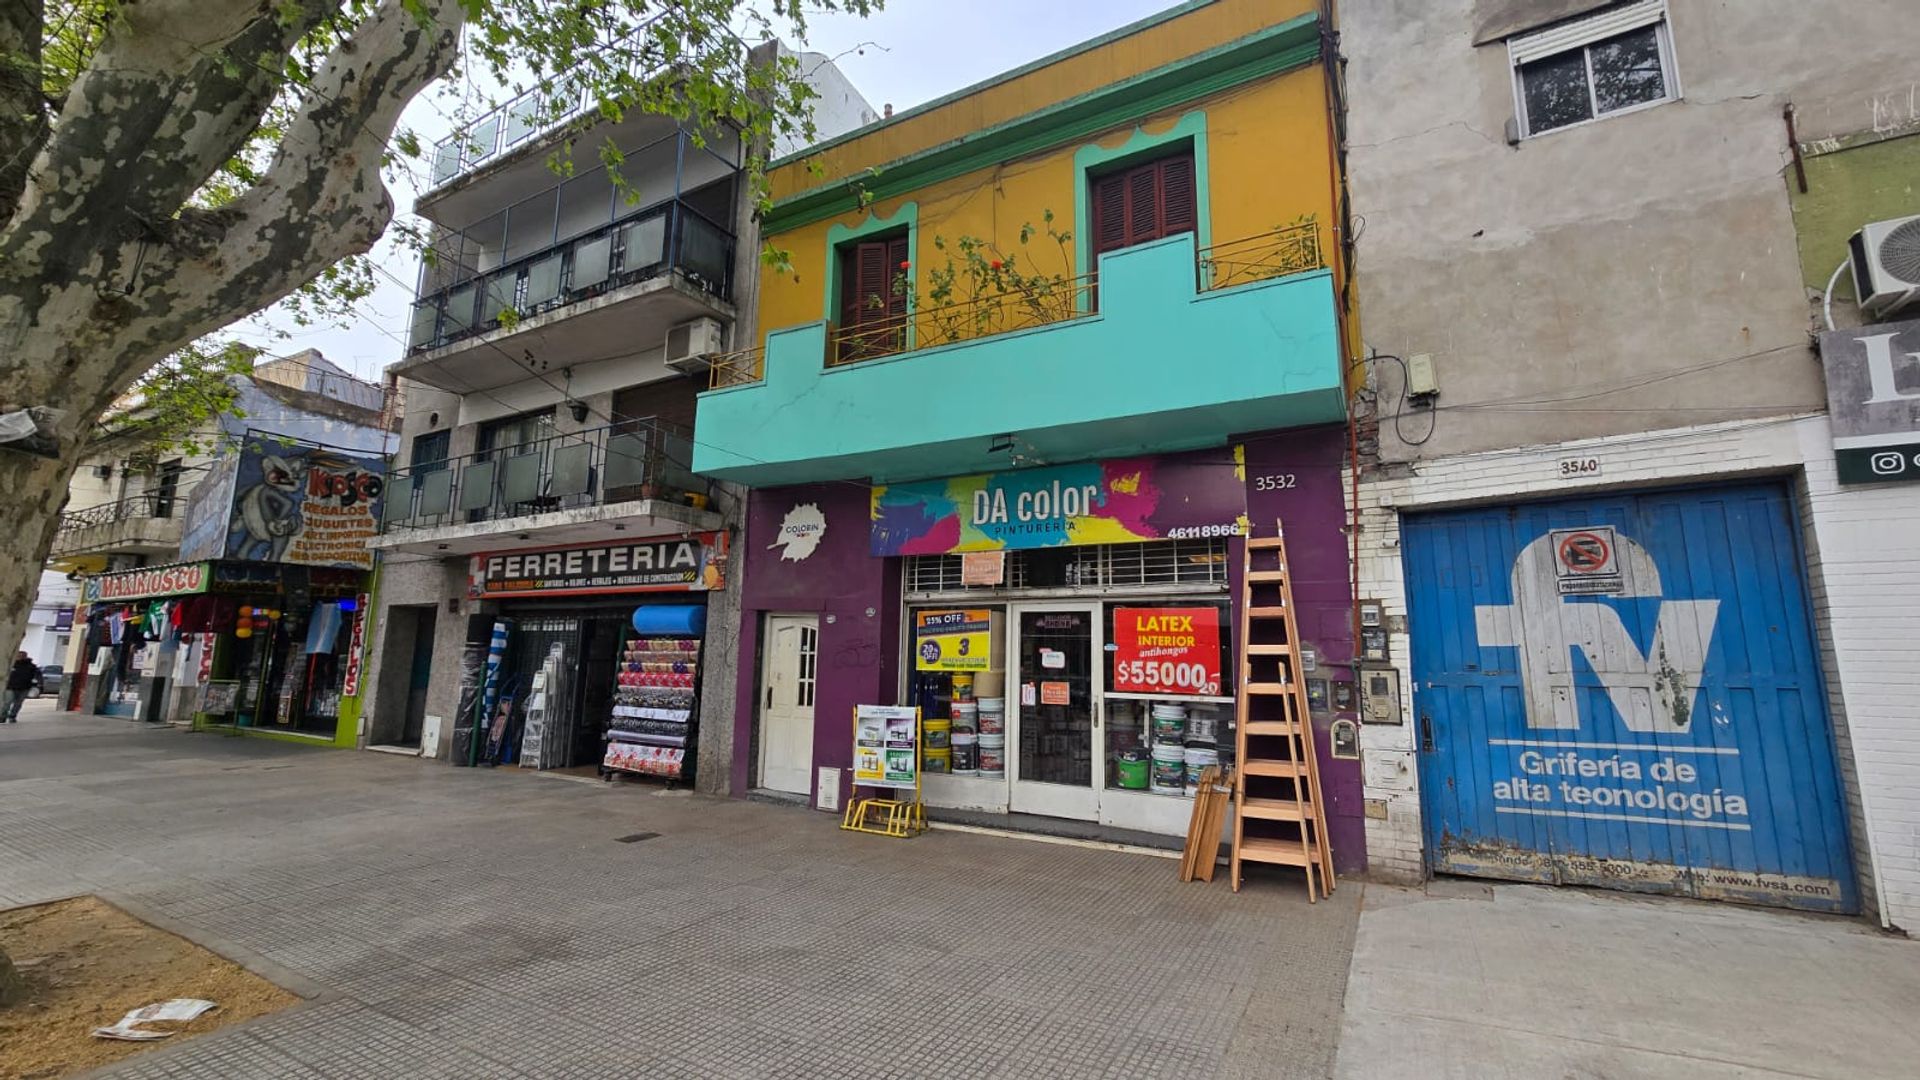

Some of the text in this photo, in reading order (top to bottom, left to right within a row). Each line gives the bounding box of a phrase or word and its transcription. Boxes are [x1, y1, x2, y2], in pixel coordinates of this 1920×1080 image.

[1561, 459, 1597, 474] 3540
[1256, 474, 1296, 491] 3532
[303, 502, 367, 516] REGALOS
[973, 480, 1097, 525] DA color
[304, 517, 374, 529] JUGUETES
[1168, 523, 1239, 539] 46118966
[487, 542, 697, 579] FERRETERIA
[101, 564, 202, 599] MAXIKIOSCO
[944, 614, 962, 623] OFF
[1137, 615, 1193, 632] LATEX
[345, 594, 367, 694] REGALOS
[958, 638, 969, 656] 3
[1138, 635, 1195, 647] INTERIOR
[1139, 647, 1188, 658] antihongos
[1118, 660, 1206, 688] $55000
[1519, 751, 1697, 783] Grifería de
[1493, 777, 1550, 802] alta
[1713, 874, 1831, 896] www.fvsa.com
